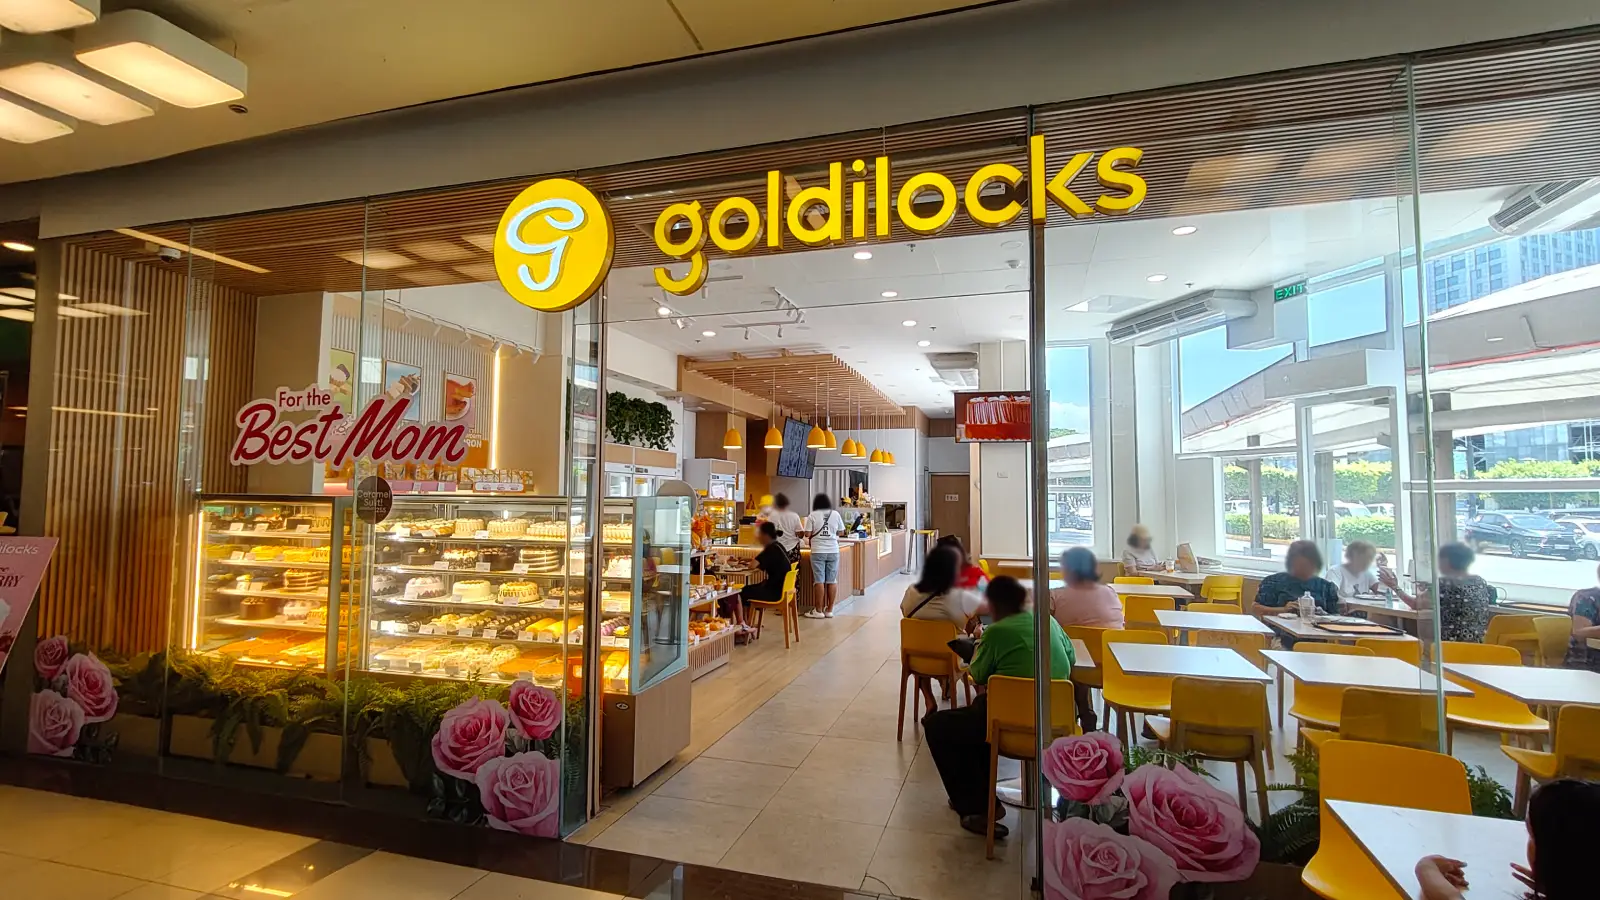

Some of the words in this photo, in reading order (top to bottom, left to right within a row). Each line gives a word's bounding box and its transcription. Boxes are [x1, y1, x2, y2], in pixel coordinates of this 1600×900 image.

[654, 134, 1148, 295] goldilocks
[1275, 283, 1305, 300] EXIT
[278, 391, 303, 407] For
[307, 388, 331, 405] the
[233, 402, 344, 461] Best
[333, 397, 466, 467] Mom
[357, 489, 391, 499] Caramel
